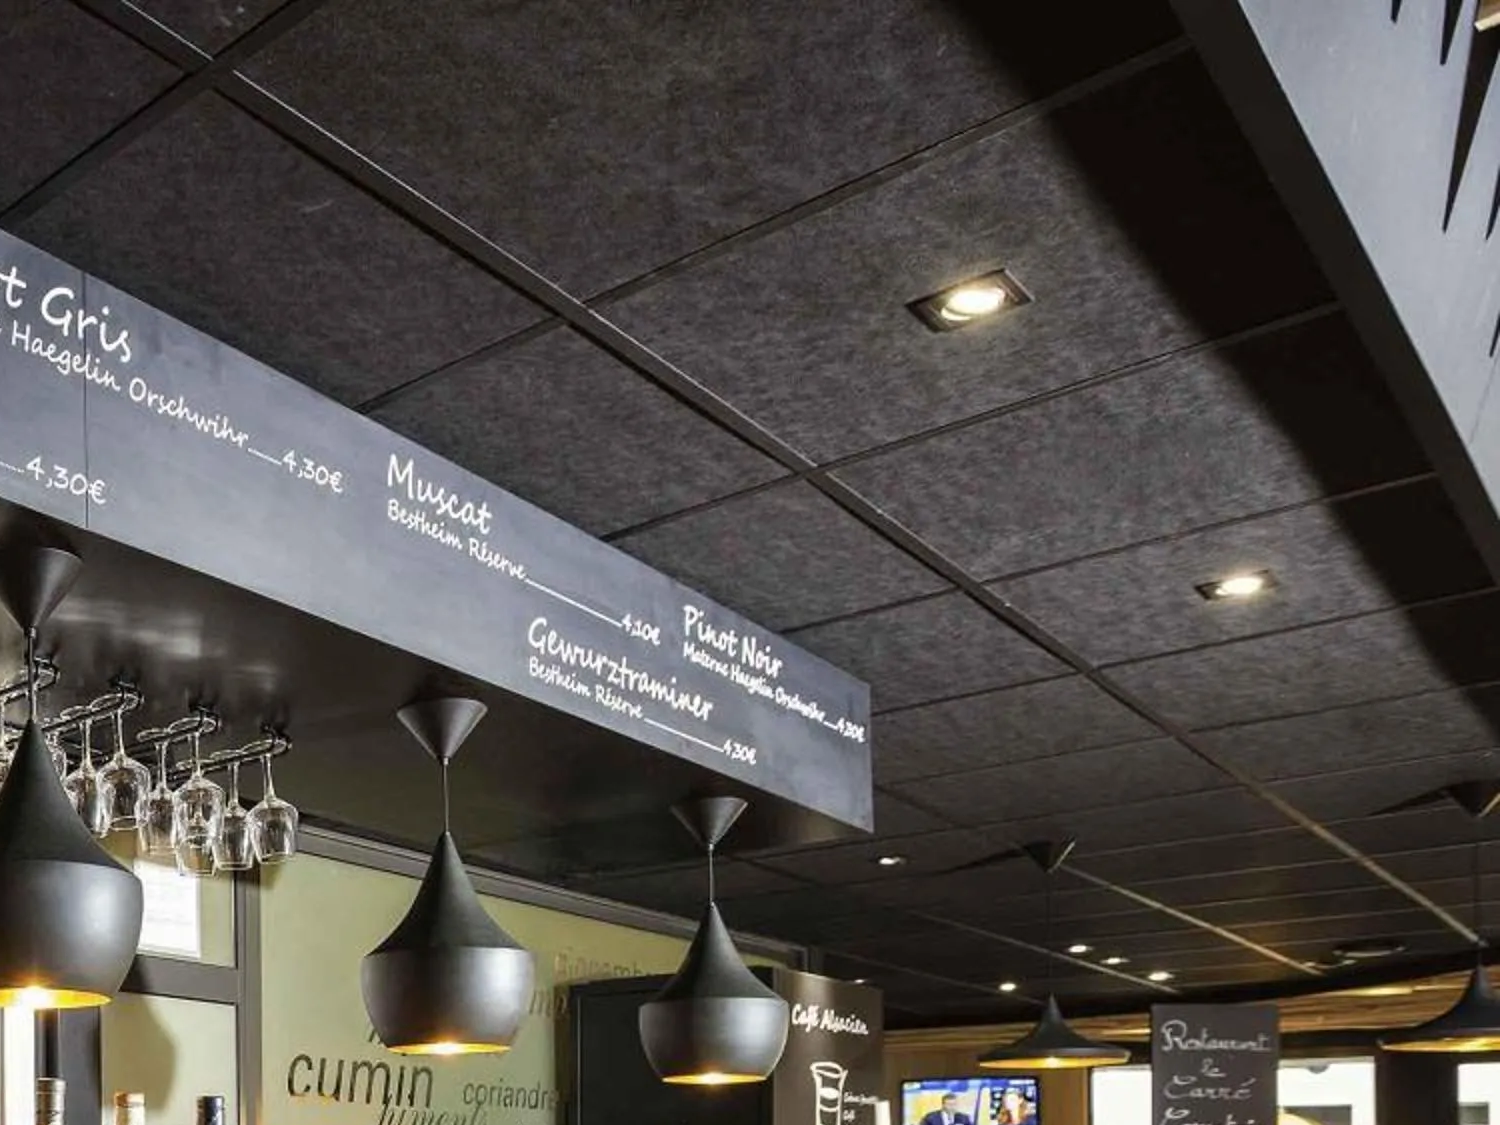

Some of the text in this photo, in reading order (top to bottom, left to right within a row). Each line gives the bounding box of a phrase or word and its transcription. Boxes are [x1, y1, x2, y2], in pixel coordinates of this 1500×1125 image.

[41, 287, 132, 364] Gris
[11, 320, 121, 392] Haegelin
[129, 377, 250, 449] Orschwihr
[282, 450, 345, 494] 4,30€
[25, 456, 107, 505] 4,30€
[387, 453, 493, 534] Muscat
[387, 499, 463, 550] Bestheim
[468, 537, 527, 580] Réserve
[528, 616, 714, 721] Gewurztraminer
[528, 656, 591, 697] Bestheim
[683, 605, 784, 679] Pinot Noir
[287, 1053, 434, 1108] cumin
